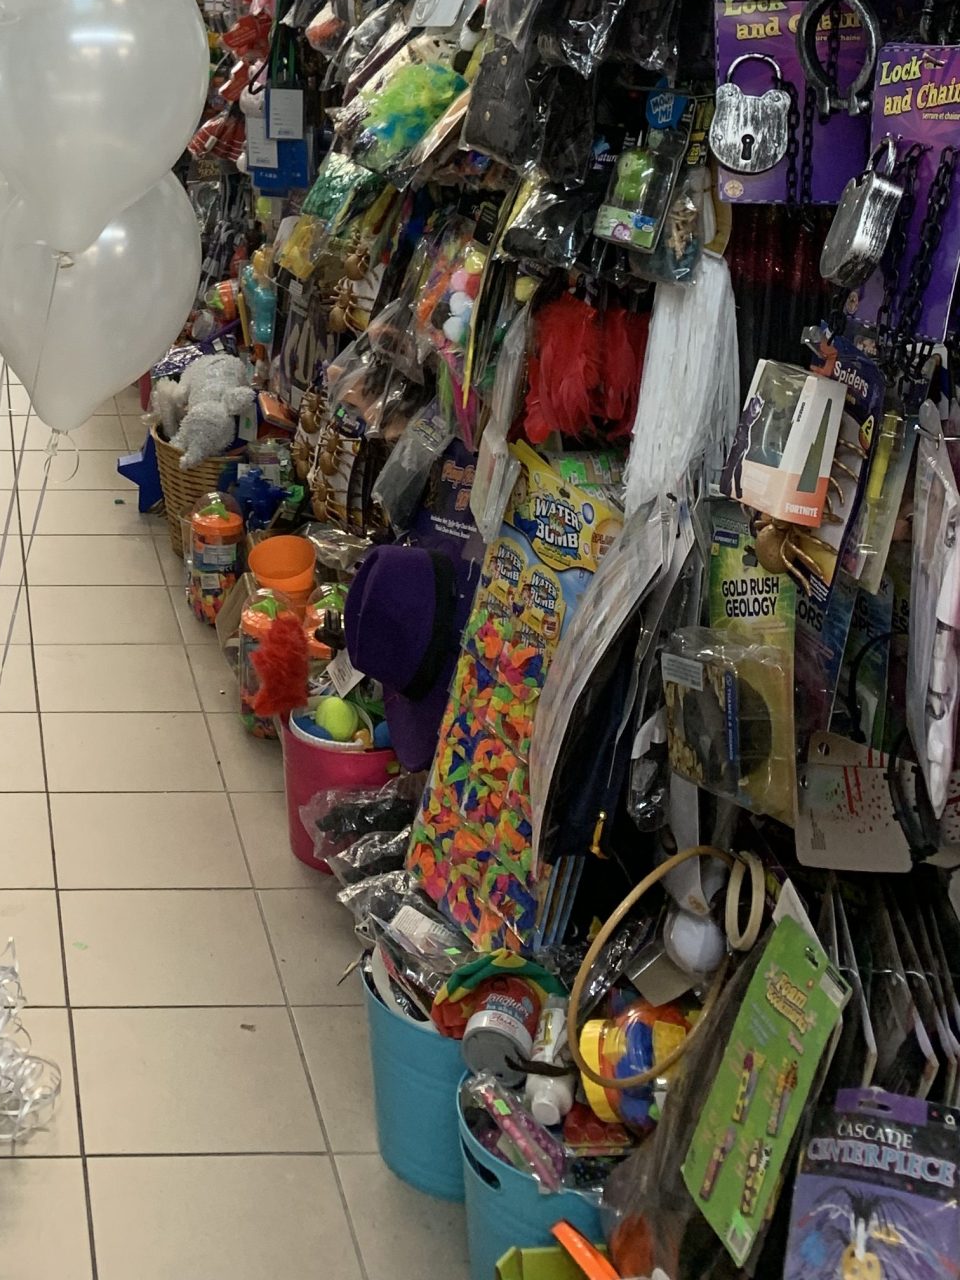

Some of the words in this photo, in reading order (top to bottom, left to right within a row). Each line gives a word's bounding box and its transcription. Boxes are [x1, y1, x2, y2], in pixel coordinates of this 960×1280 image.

[736, 16, 782, 40] and
[880, 56, 923, 86] Lock
[884, 87, 913, 116] and
[833, 360, 869, 399] Spiders
[535, 497, 580, 532] WATER
[784, 502, 819, 518] FORTNITE
[535, 520, 579, 550] BOMB
[498, 544, 522, 571] WATER
[531, 571, 557, 599] WATER
[722, 578, 748, 597] GOLD
[750, 576, 780, 595] RUSH
[725, 596, 777, 618] GEOLOGY
[796, 599, 824, 633] ORS
[838, 1122, 913, 1149] CASCADE
[807, 1137, 957, 1188] CENTERPIECE
